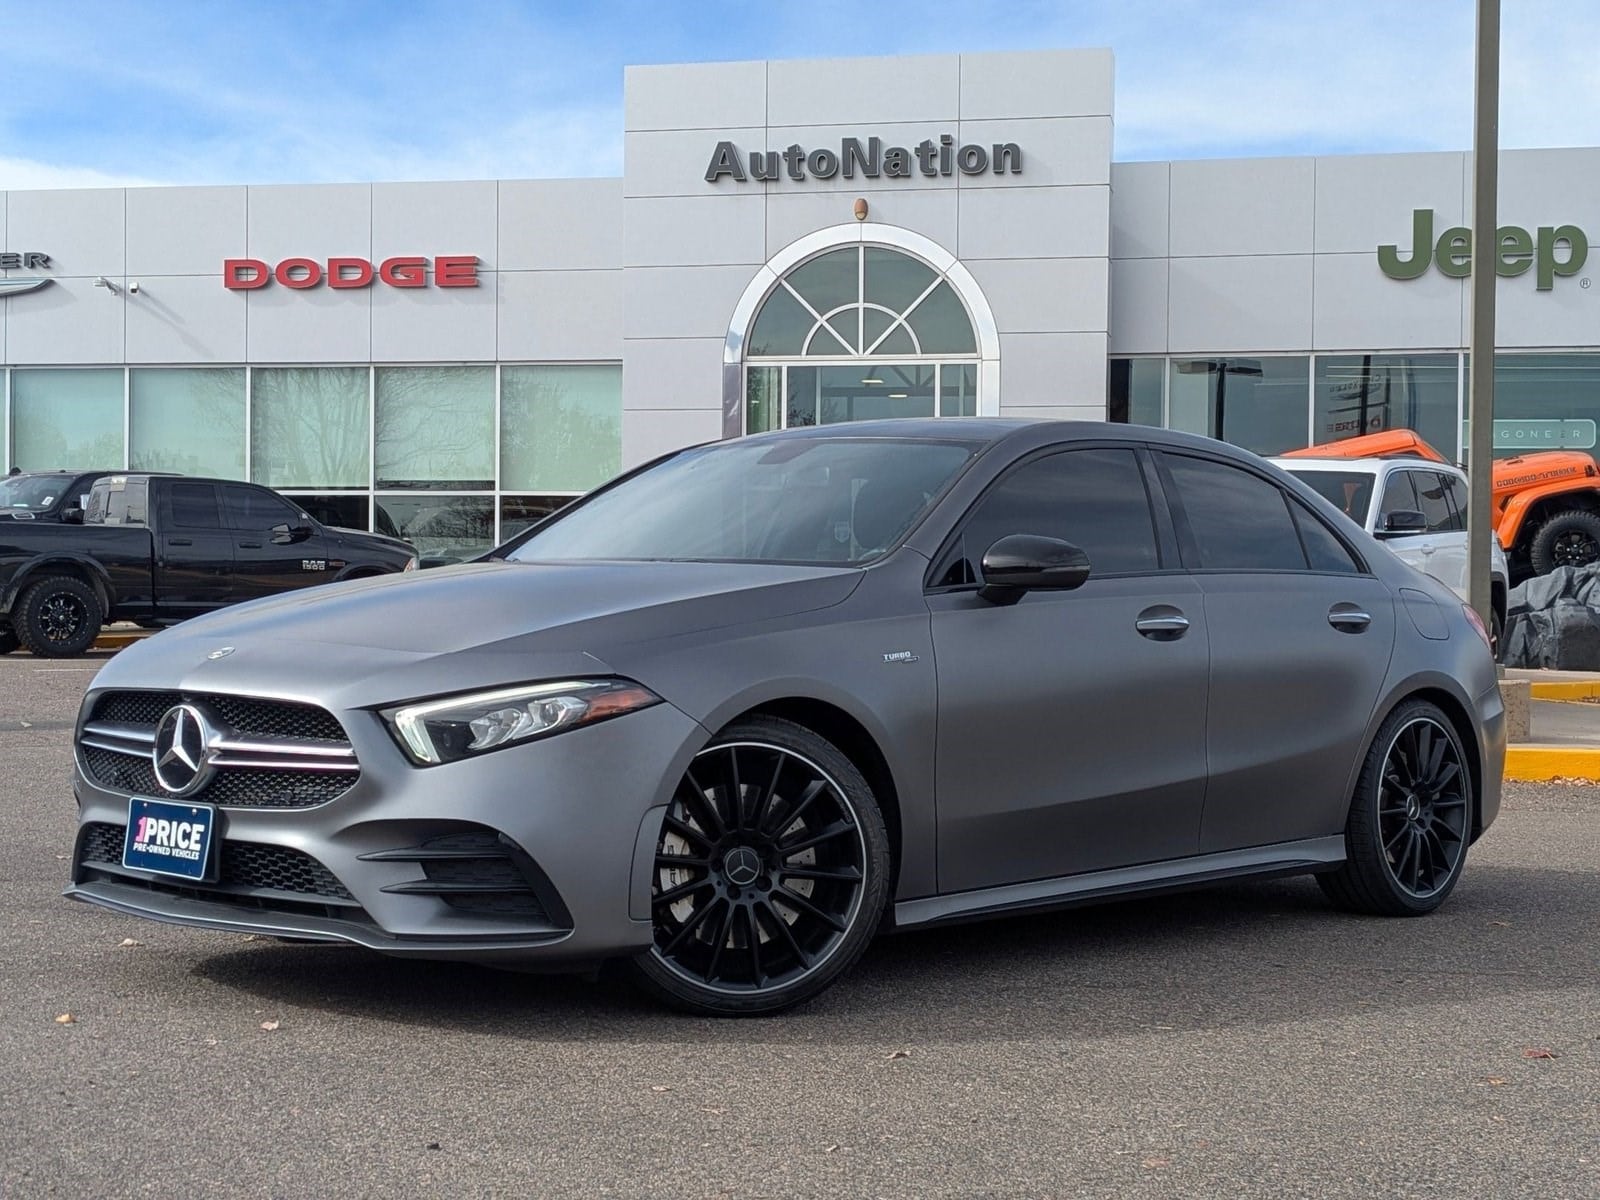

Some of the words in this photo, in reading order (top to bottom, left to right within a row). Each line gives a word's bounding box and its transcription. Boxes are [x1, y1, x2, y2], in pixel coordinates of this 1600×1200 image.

[704, 134, 1022, 182] AutoNation
[1377, 209, 1588, 291] Jeep
[224, 256, 479, 289] DODGE
[883, 651, 911, 661] TURBO
[134, 816, 205, 851] 1PRICE
[133, 842, 170, 856] PRE-OWNED
[171, 848, 200, 860] VEHICLES
